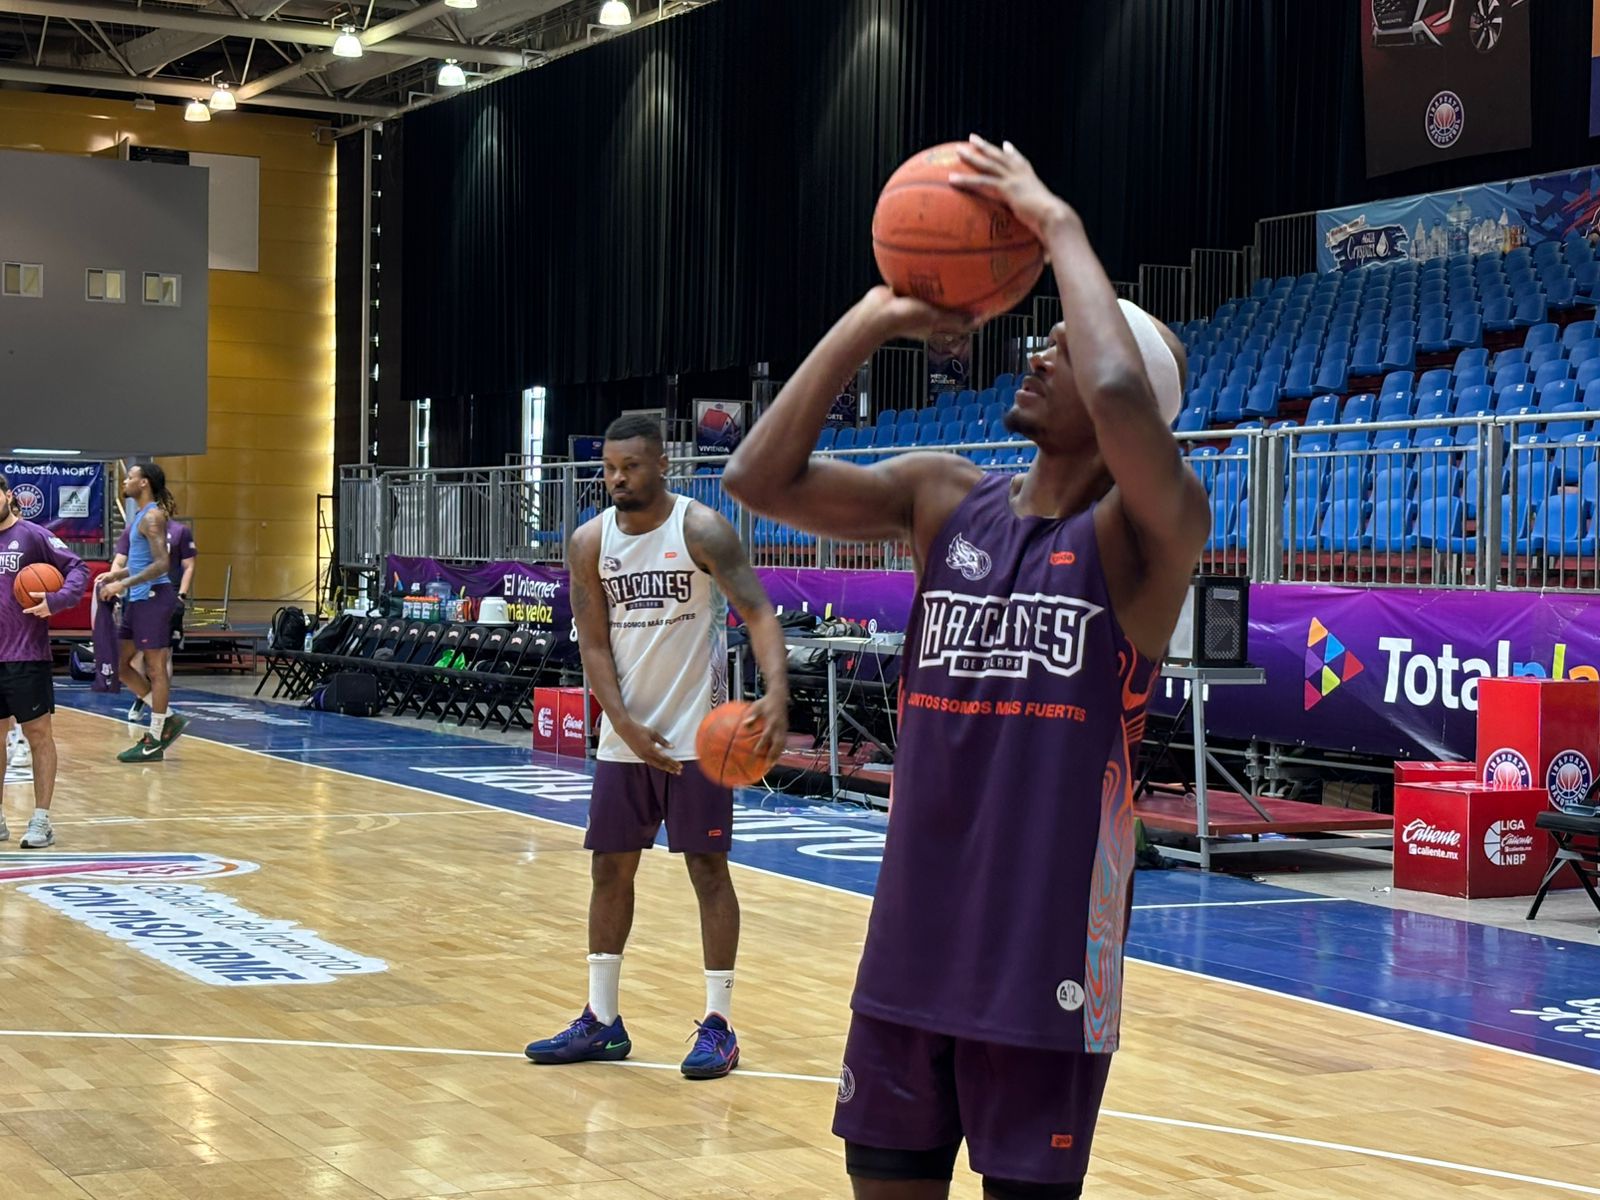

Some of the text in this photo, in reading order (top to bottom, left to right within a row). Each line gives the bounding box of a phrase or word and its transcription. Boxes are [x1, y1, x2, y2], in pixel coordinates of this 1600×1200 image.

[699, 445, 730, 453] VIVIENDA
[4, 464, 95, 476] CABECERA NORTE
[503, 573, 561, 598] El Internet
[526, 601, 553, 623] veloz
[940, 697, 992, 715] SOMOS
[1024, 702, 1086, 722] FUERTES
[1488, 753, 1527, 776] IRAPUATO
[1551, 755, 1588, 776] IRAPUATO
[1402, 818, 1461, 847] Caliente
[1501, 819, 1526, 831] LIGA
[1501, 854, 1526, 866] LNBP
[39, 884, 307, 982] CON PASO FIRME
[240, 932, 363, 971] Irapuato
